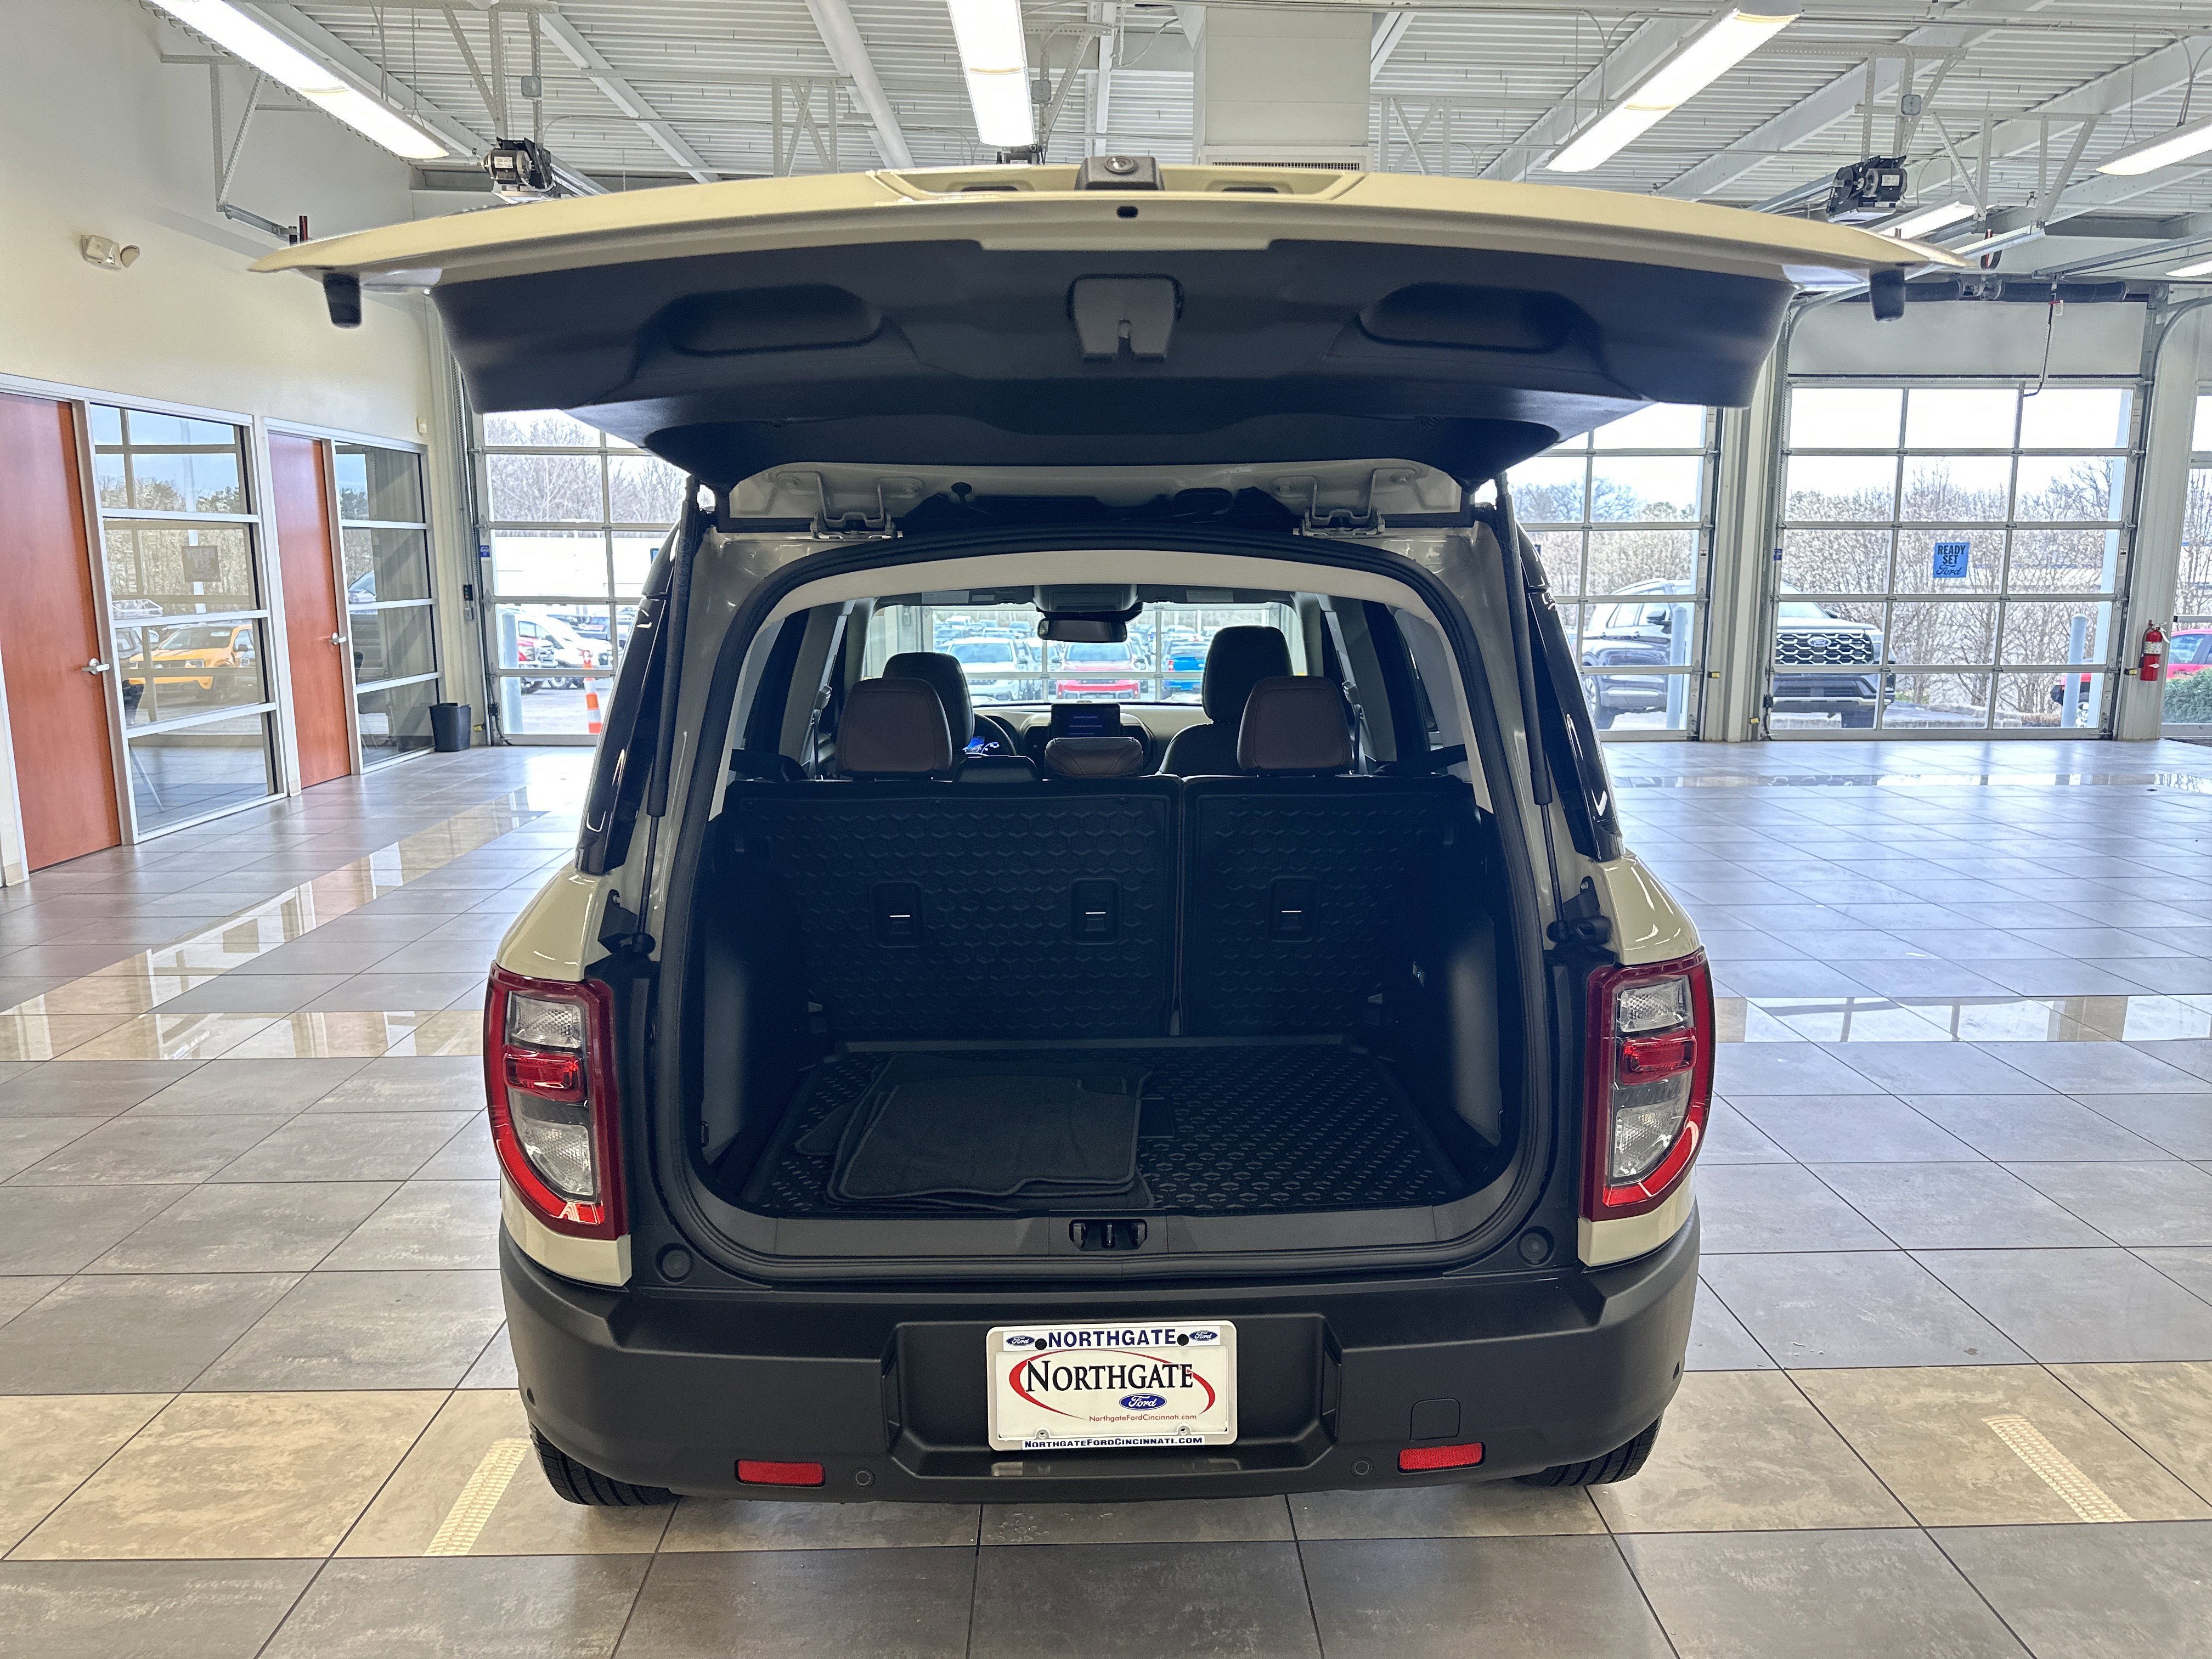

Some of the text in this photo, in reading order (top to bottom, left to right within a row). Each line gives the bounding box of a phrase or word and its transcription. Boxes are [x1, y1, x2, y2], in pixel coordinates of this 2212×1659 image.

[1937, 545, 1966, 555] READY
[1943, 555, 1959, 565] SET
[1936, 565, 1963, 575] Ford
[1048, 1329, 1176, 1347] NORTHGATE
[1025, 1360, 1193, 1392] NORTHGATE
[1128, 1396, 1157, 1407] Ford
[1089, 1414, 1197, 1423] NorthgateFordCincinnati.com
[1025, 1437, 1203, 1448] NORTHGATEFORDCINCINNATI.COM
